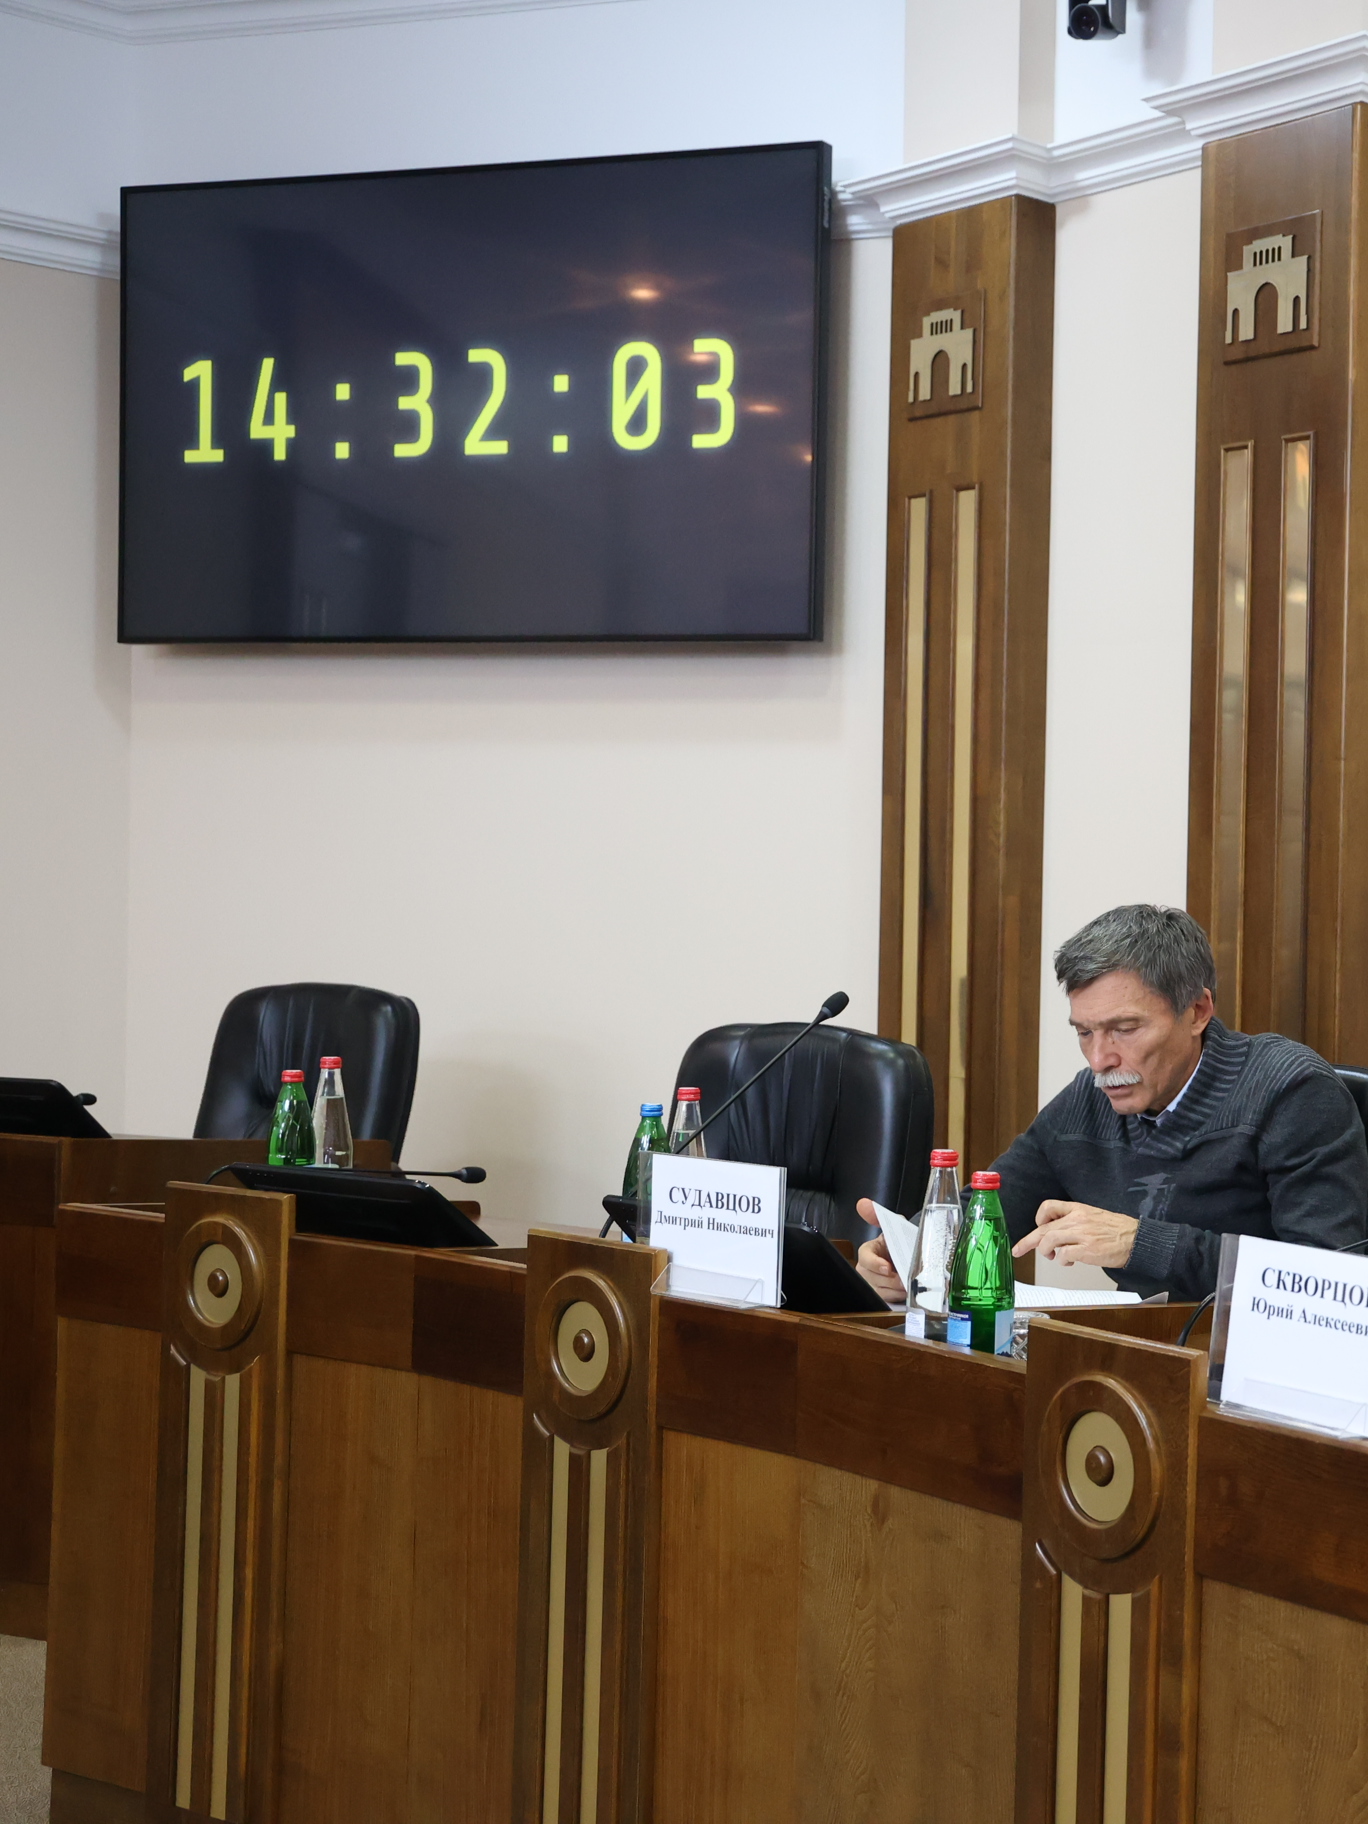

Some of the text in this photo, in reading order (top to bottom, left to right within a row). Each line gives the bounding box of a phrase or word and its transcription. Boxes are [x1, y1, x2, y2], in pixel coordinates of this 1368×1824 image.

[183, 337, 736, 464] 14:32:03
[668, 1186, 762, 1215] СУДАВЦОВ
[654, 1210, 775, 1239] Дмитрий Николаевич
[1250, 1296, 1294, 1321] Юрий
